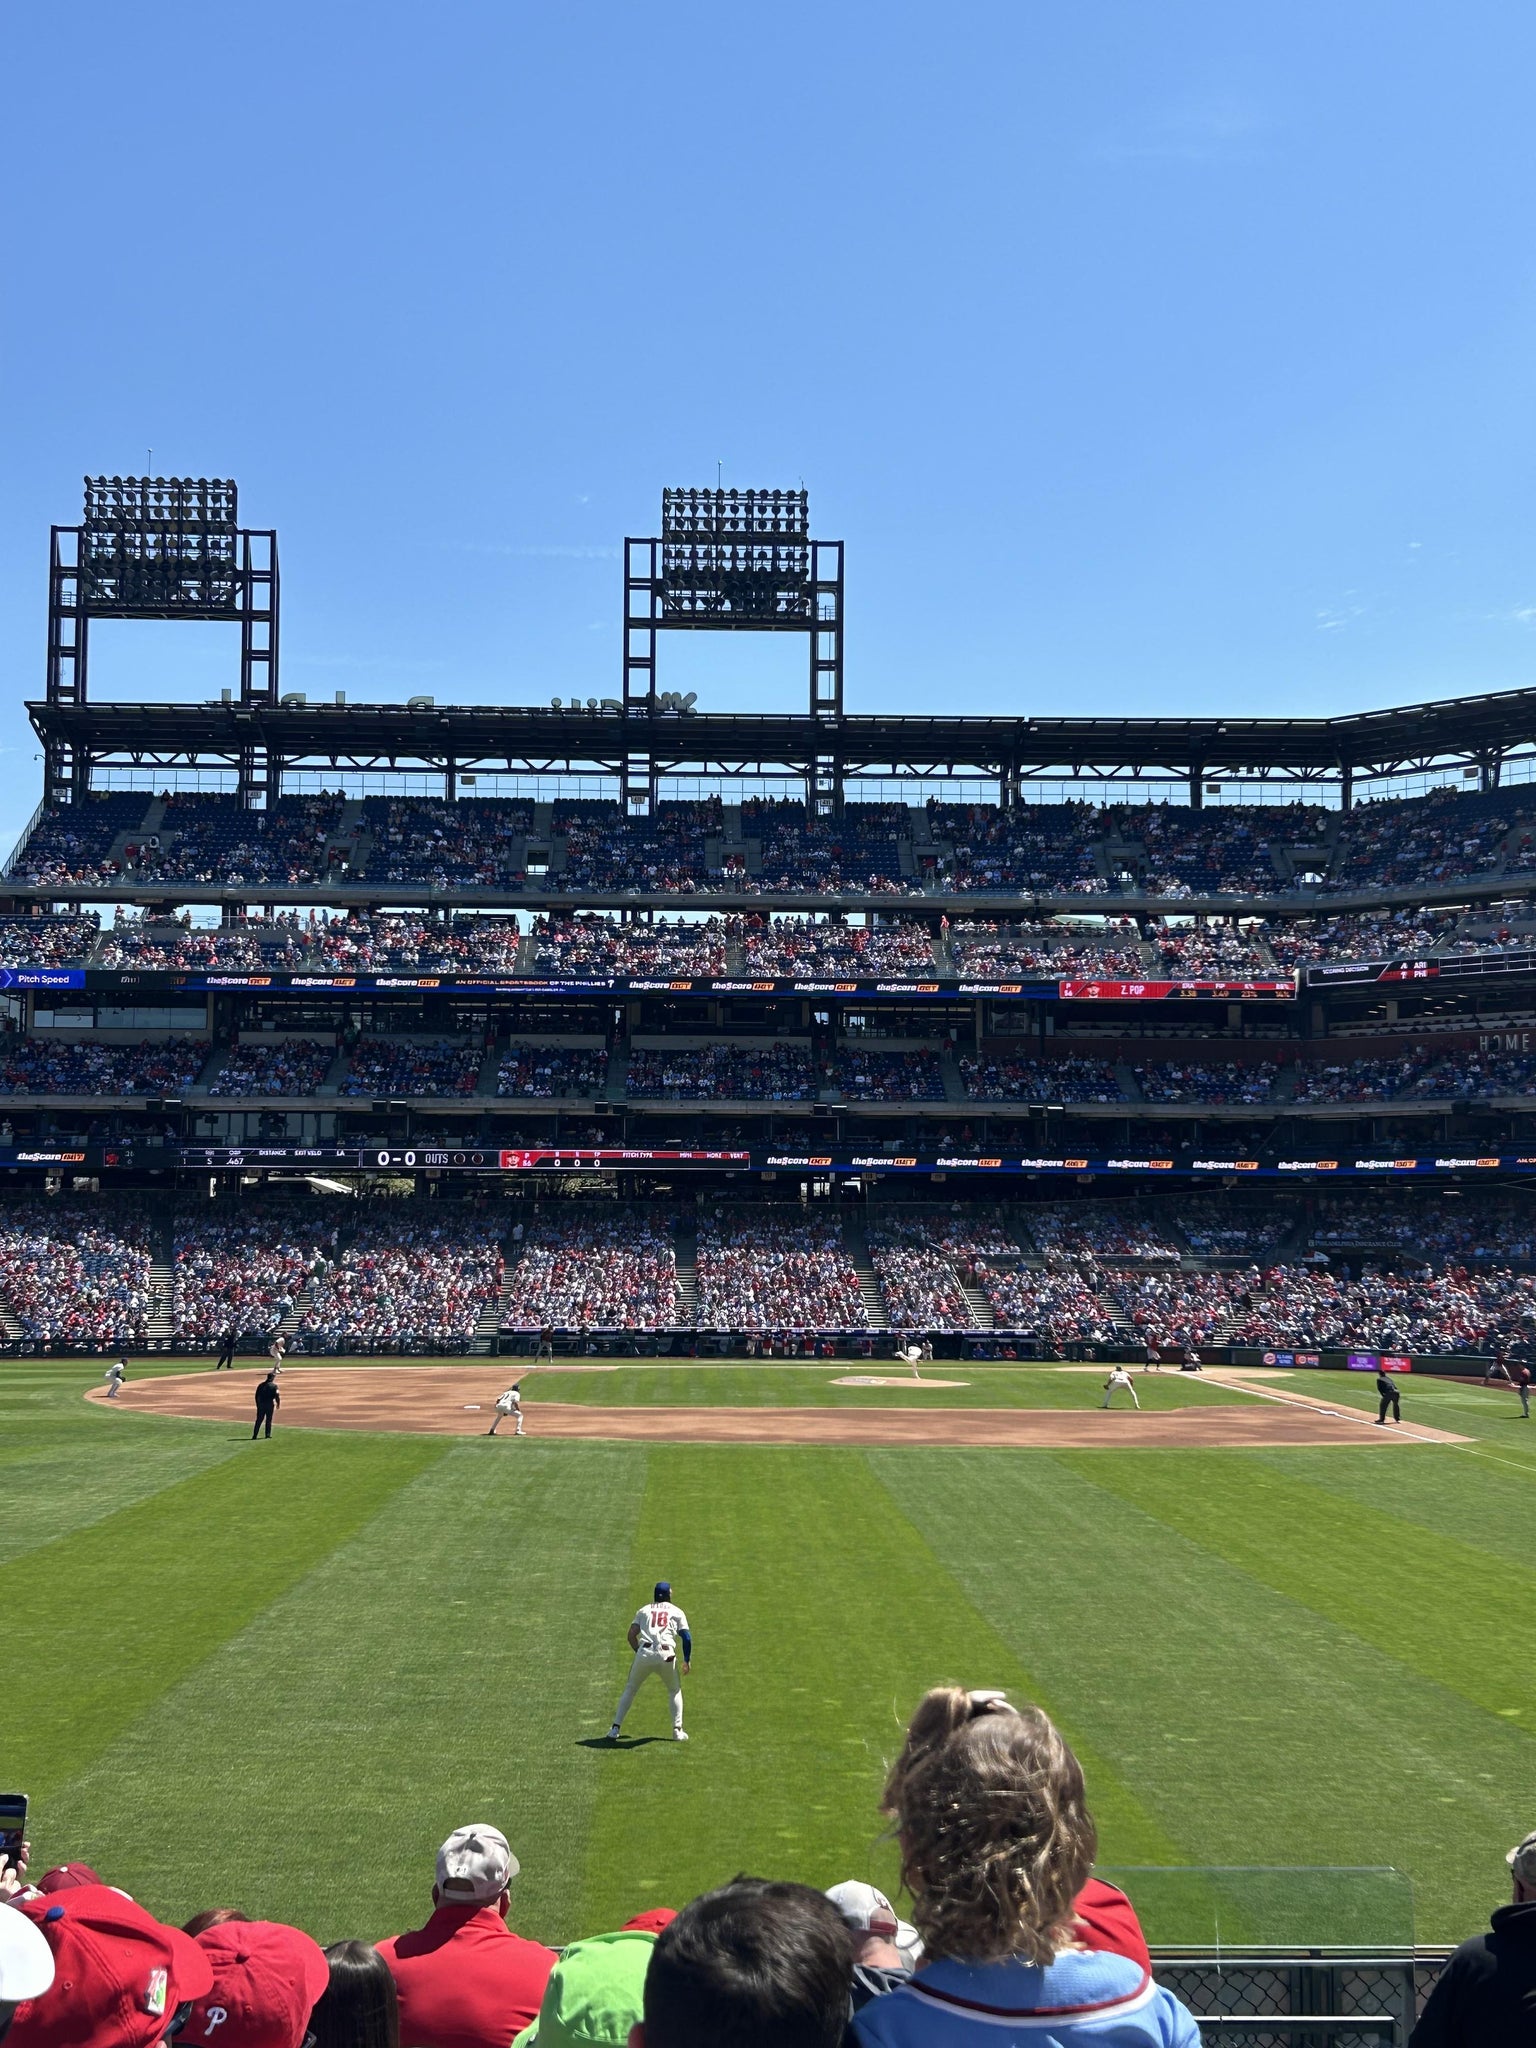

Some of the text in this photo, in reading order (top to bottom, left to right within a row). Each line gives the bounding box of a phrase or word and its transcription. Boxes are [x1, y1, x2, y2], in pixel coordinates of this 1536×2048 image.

[18, 975, 70, 984] Pitch Speed
[1130, 986, 1145, 995] POP
[425, 1153, 449, 1164] OUTS
[554, 1159, 560, 1167] 0
[574, 1159, 580, 1167] 0
[594, 1159, 600, 1167] 0
[204, 2006, 228, 2036] P
